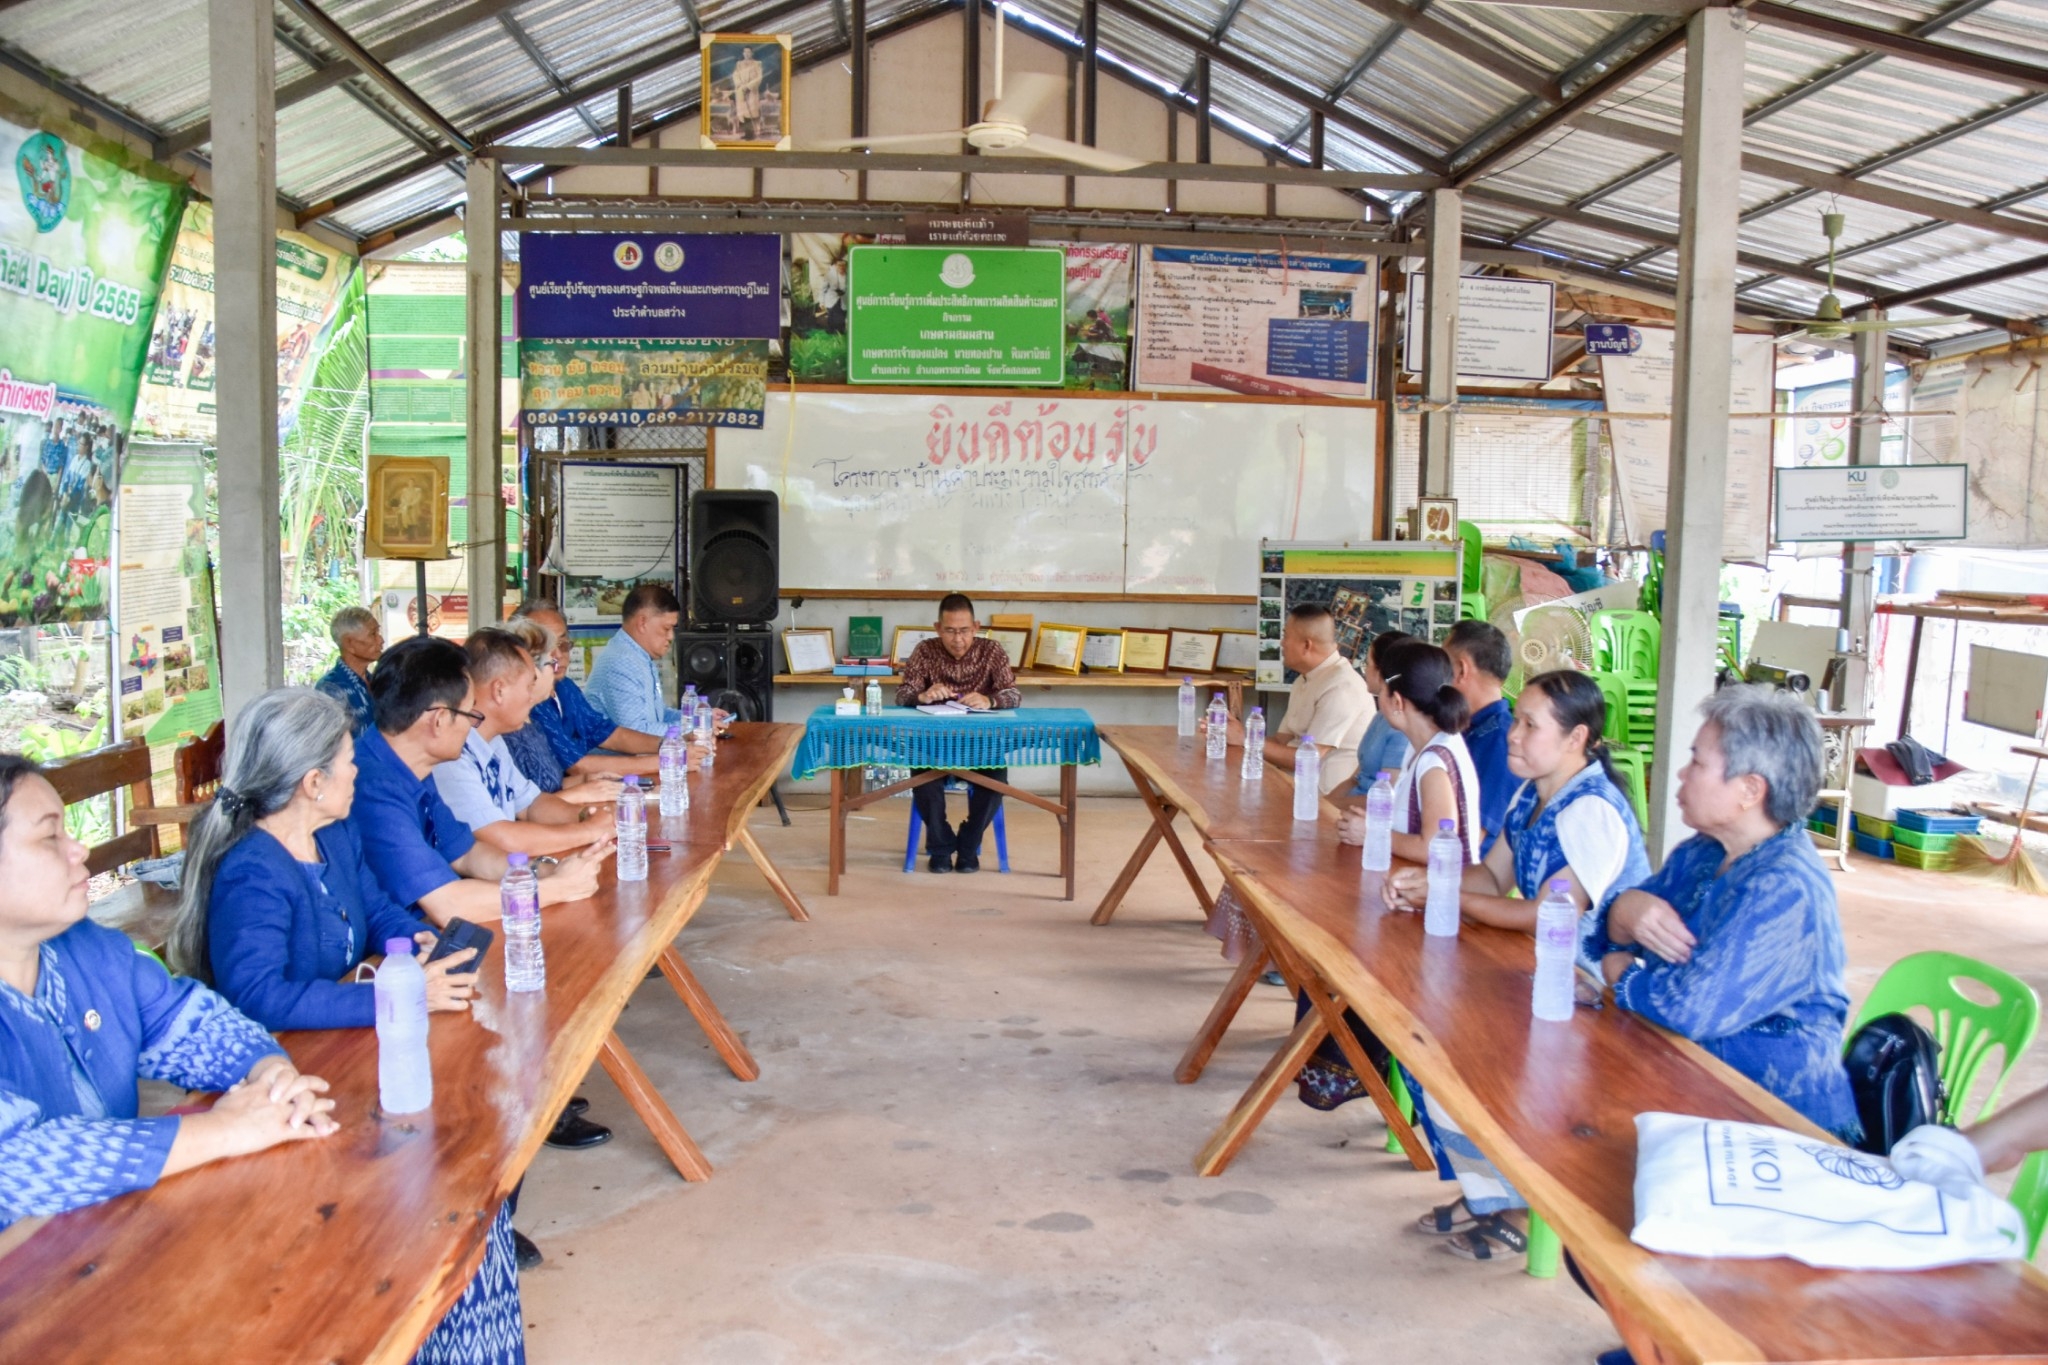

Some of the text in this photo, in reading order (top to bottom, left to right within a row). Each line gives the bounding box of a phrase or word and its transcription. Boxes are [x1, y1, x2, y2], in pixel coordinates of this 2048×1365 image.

[93, 282, 140, 321] 2565
[612, 306, 686, 319] ประจำตำบลสว่าง
[942, 312, 972, 323] กิจกรรม
[919, 329, 995, 341] เกษตรผสมผสาน
[1589, 337, 1628, 352] ฐานบัญชี
[1847, 470, 1867, 482] KU
